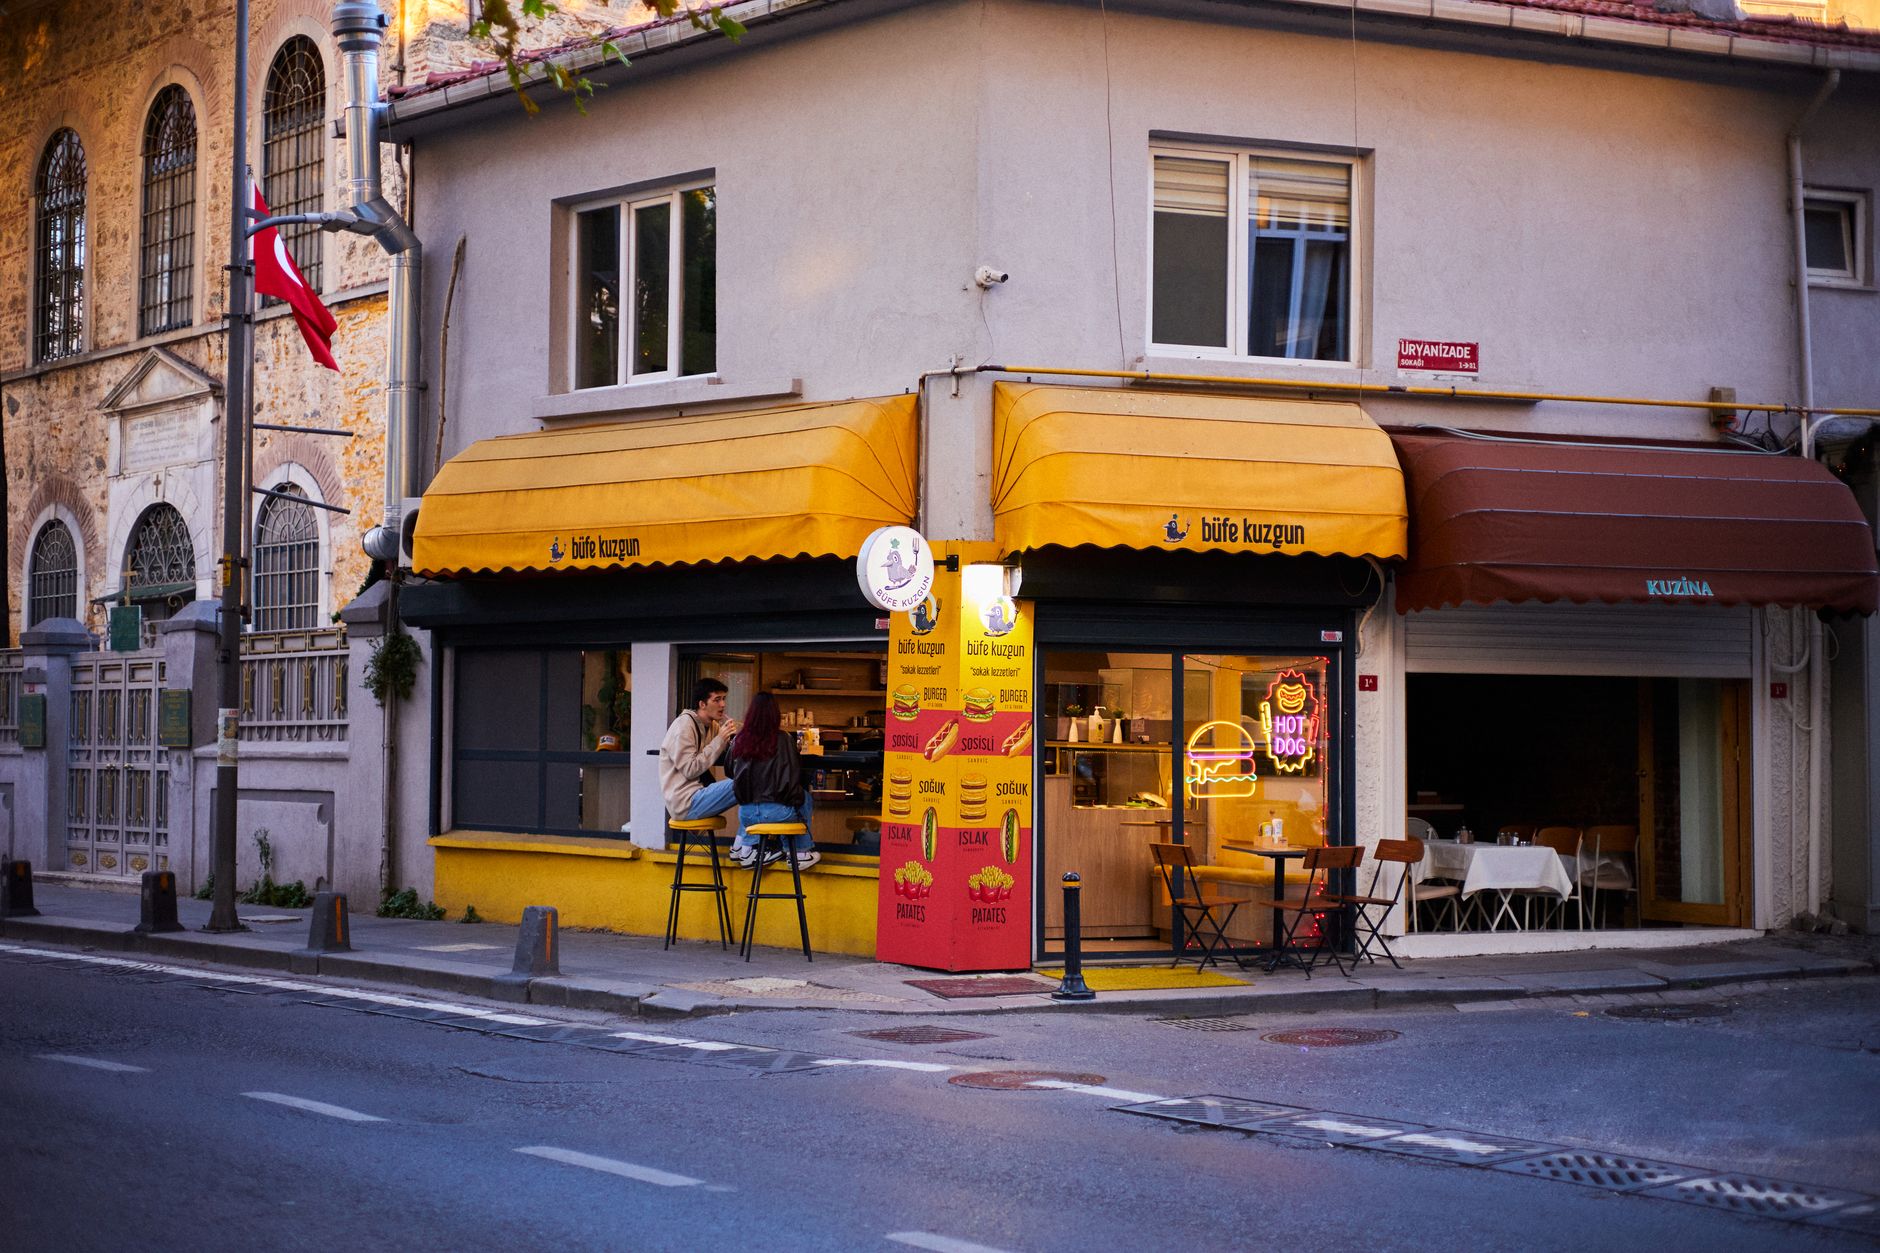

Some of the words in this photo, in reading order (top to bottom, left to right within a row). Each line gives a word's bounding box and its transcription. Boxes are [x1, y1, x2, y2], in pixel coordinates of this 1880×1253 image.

[1401, 341, 1471, 359] ÜRYANİZADE
[1400, 358, 1424, 367] SOKAĞI
[1202, 516, 1238, 543] büfe
[1244, 517, 1304, 548] kuzgun
[572, 536, 596, 560] büfe
[598, 535, 640, 561] kuzgun
[876, 588, 898, 607] BÜFE
[902, 576, 930, 607] KUZGUN
[1646, 576, 1714, 596] KUZİNA
[898, 639, 915, 655] büfe
[917, 640, 945, 658] kuzgun
[968, 640, 989, 656] büfe
[992, 640, 1024, 660] kuzgun
[924, 687, 947, 702] BURGER
[1000, 689, 1028, 704] BURGER
[1275, 716, 1306, 734] HOT
[892, 733, 918, 749] SOSİSLİ
[962, 736, 994, 752] SOSİSLİ
[1275, 738, 1306, 755] DOG
[918, 779, 946, 796] SOĞUK
[996, 780, 1028, 796] SOĞUK
[888, 826, 912, 842] ISLAK
[959, 832, 988, 846] ISLAK
[896, 903, 926, 922] PATATES
[972, 908, 1006, 924] PATATES
